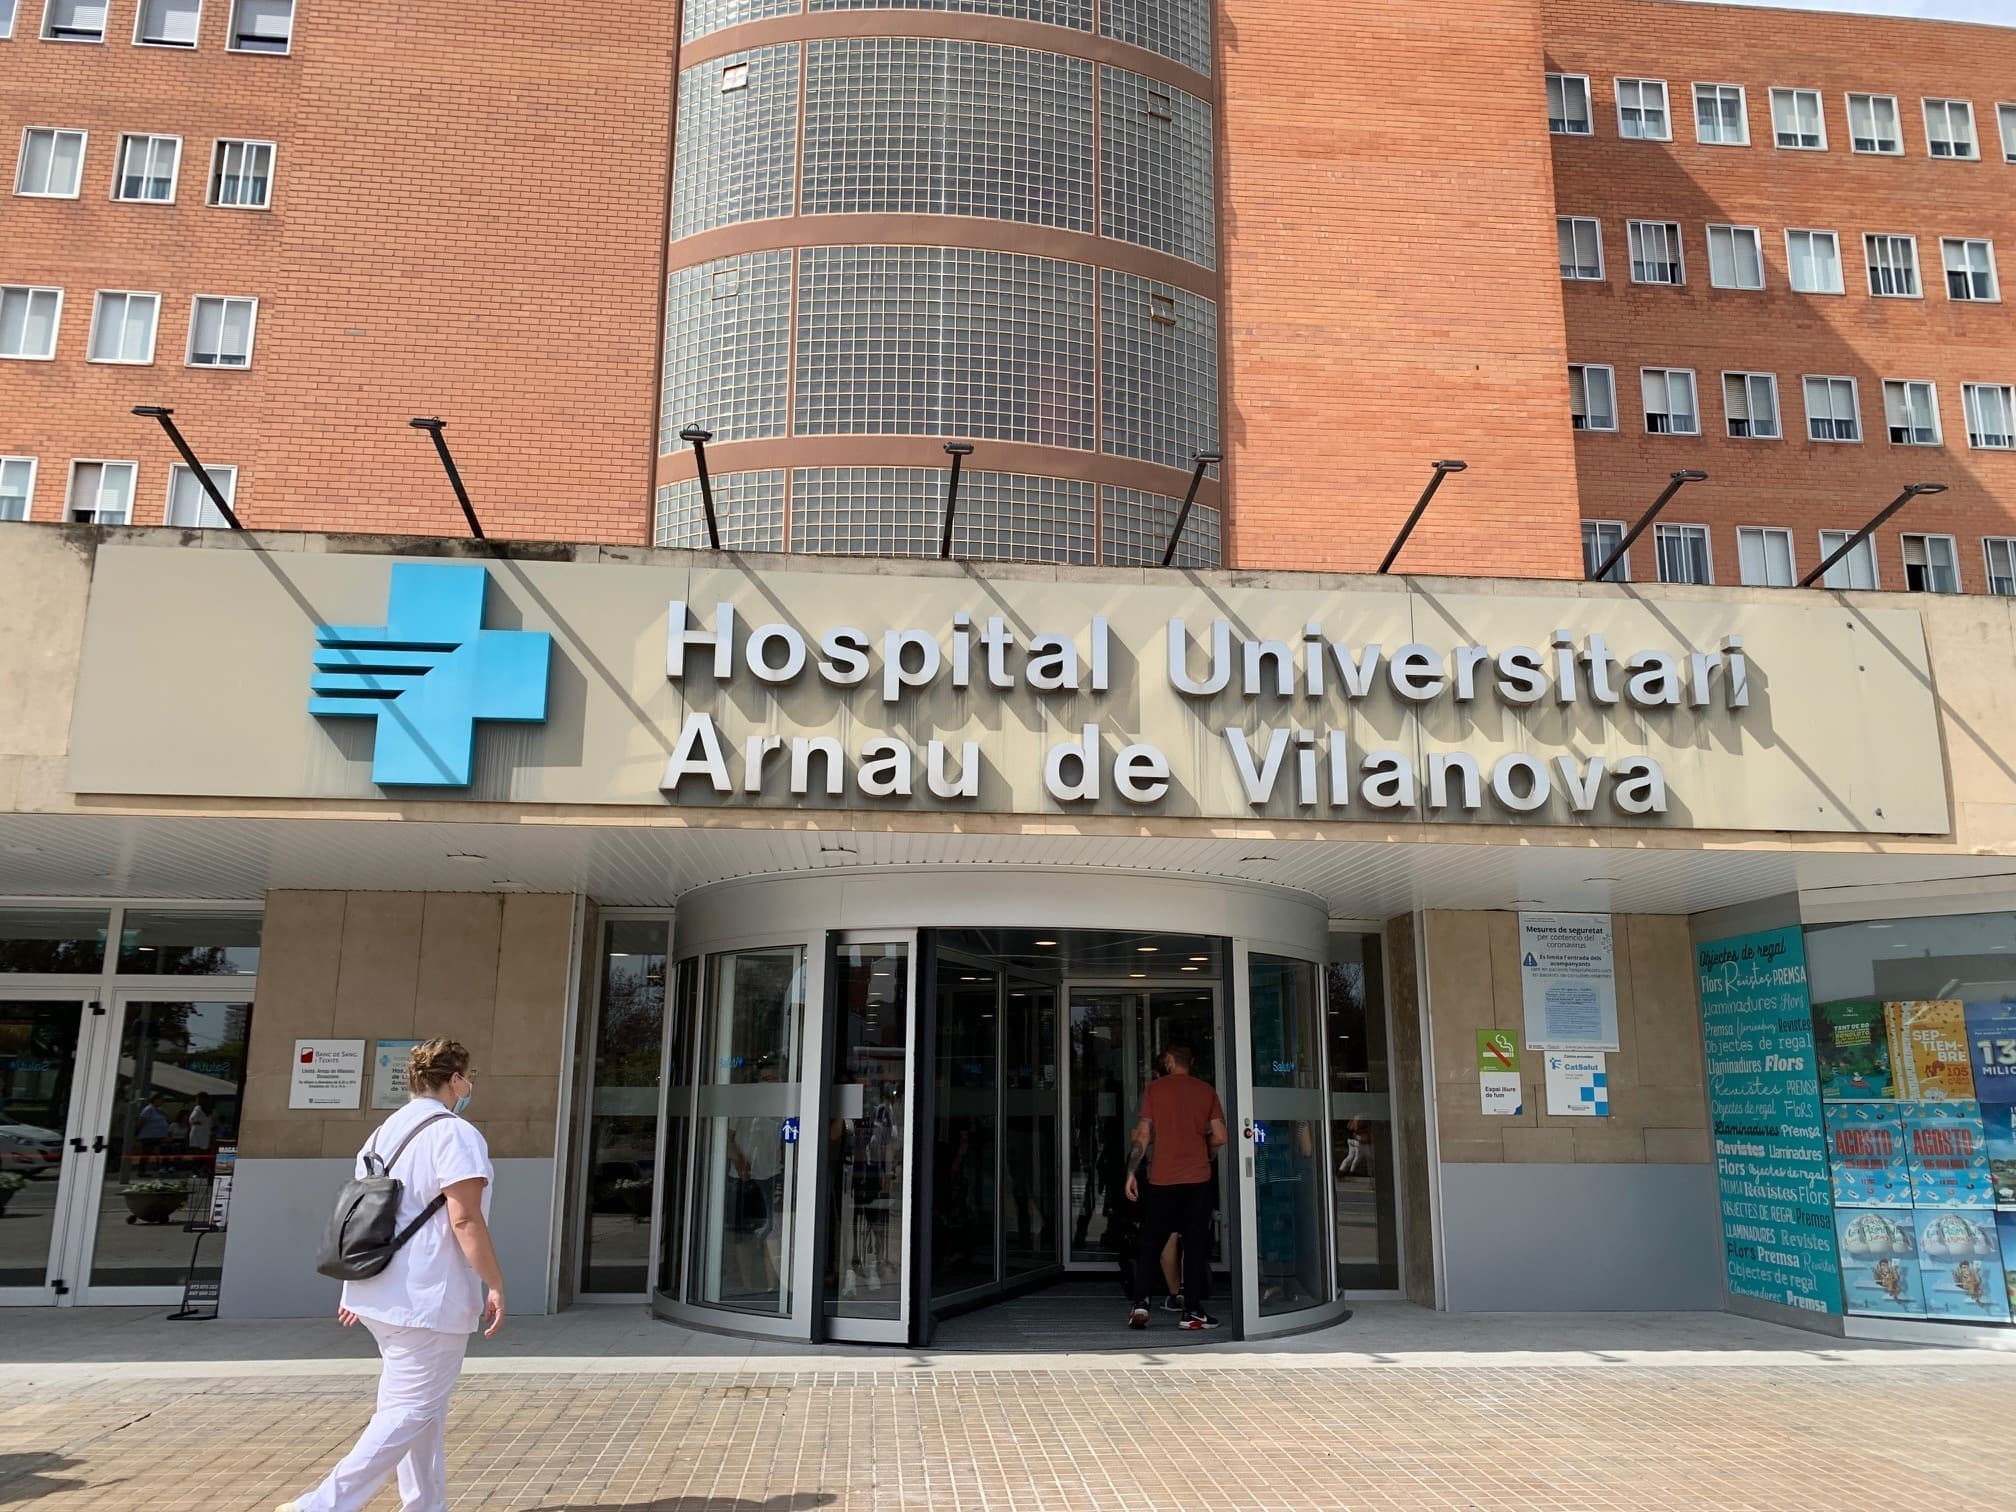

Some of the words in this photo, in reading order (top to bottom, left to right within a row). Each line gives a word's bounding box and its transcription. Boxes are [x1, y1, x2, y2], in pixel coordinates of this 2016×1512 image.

[666, 600, 1109, 701] Hospital
[1166, 618, 1748, 709] Universitari
[658, 711, 980, 799] Arnau
[1044, 723, 1170, 802] de
[1222, 727, 1669, 815] Vilanova
[1569, 928, 1603, 936] seguretat
[1700, 946, 1738, 972] Objectes
[1742, 944, 1754, 960] de
[1758, 936, 1786, 962] regal
[1702, 976, 1723, 993] Flors
[1720, 961, 1773, 997] Revistes
[1772, 965, 1807, 985] PREMSA
[1704, 996, 1777, 1018] Llaminadures
[1704, 1022, 1734, 1037] Premsa
[1778, 1017, 1811, 1033] Revistes
[1912, 1029, 1947, 1041] SEP-
[1704, 1040, 1753, 1056] Objectes
[1759, 1036, 1773, 1050] de
[1779, 1033, 1813, 1052] regal
[1920, 1040, 1964, 1052] TIEM-
[1708, 1057, 1762, 1075] Llaminadures
[1765, 1054, 1804, 1072] Flors
[1938, 1051, 1967, 1062] BRE
[1711, 1073, 1783, 1095] Revistes
[1786, 1080, 1818, 1096] PREMSA
[1712, 1100, 1742, 1121] Objectes
[1745, 1098, 1754, 1114] de
[1756, 1100, 1776, 1120] regal
[1781, 1124, 1821, 1138] Premsa
[1835, 1128, 1893, 1156] AGOSTO
[1912, 1128, 1974, 1156] AGOSTO
[1716, 1140, 1765, 1158] Revistes
[1769, 1144, 1823, 1161] Llaminadures
[1718, 1158, 1746, 1176] Flors
[1787, 1167, 1799, 1178] de
[1800, 1168, 1828, 1188] regal
[1744, 1182, 1798, 1201] Revistes
[1798, 1186, 1829, 1206] Flors
[1723, 1200, 1758, 1220] OBJECTES
[1760, 1204, 1769, 1221] DE
[1770, 1206, 1797, 1224] REGAL
[1796, 1208, 1831, 1230] Premsa
[1725, 1222, 1776, 1244] LLAMINADURES
[1781, 1228, 1831, 1252] Revistes
[1728, 1241, 1756, 1261] Flors
[1757, 1246, 1800, 1268] Premsa
[1728, 1261, 1772, 1281] Objectes
[1774, 1269, 1788, 1285] de
[1791, 1274, 1818, 1293] regal
[1786, 1290, 1828, 1313] Premsa
